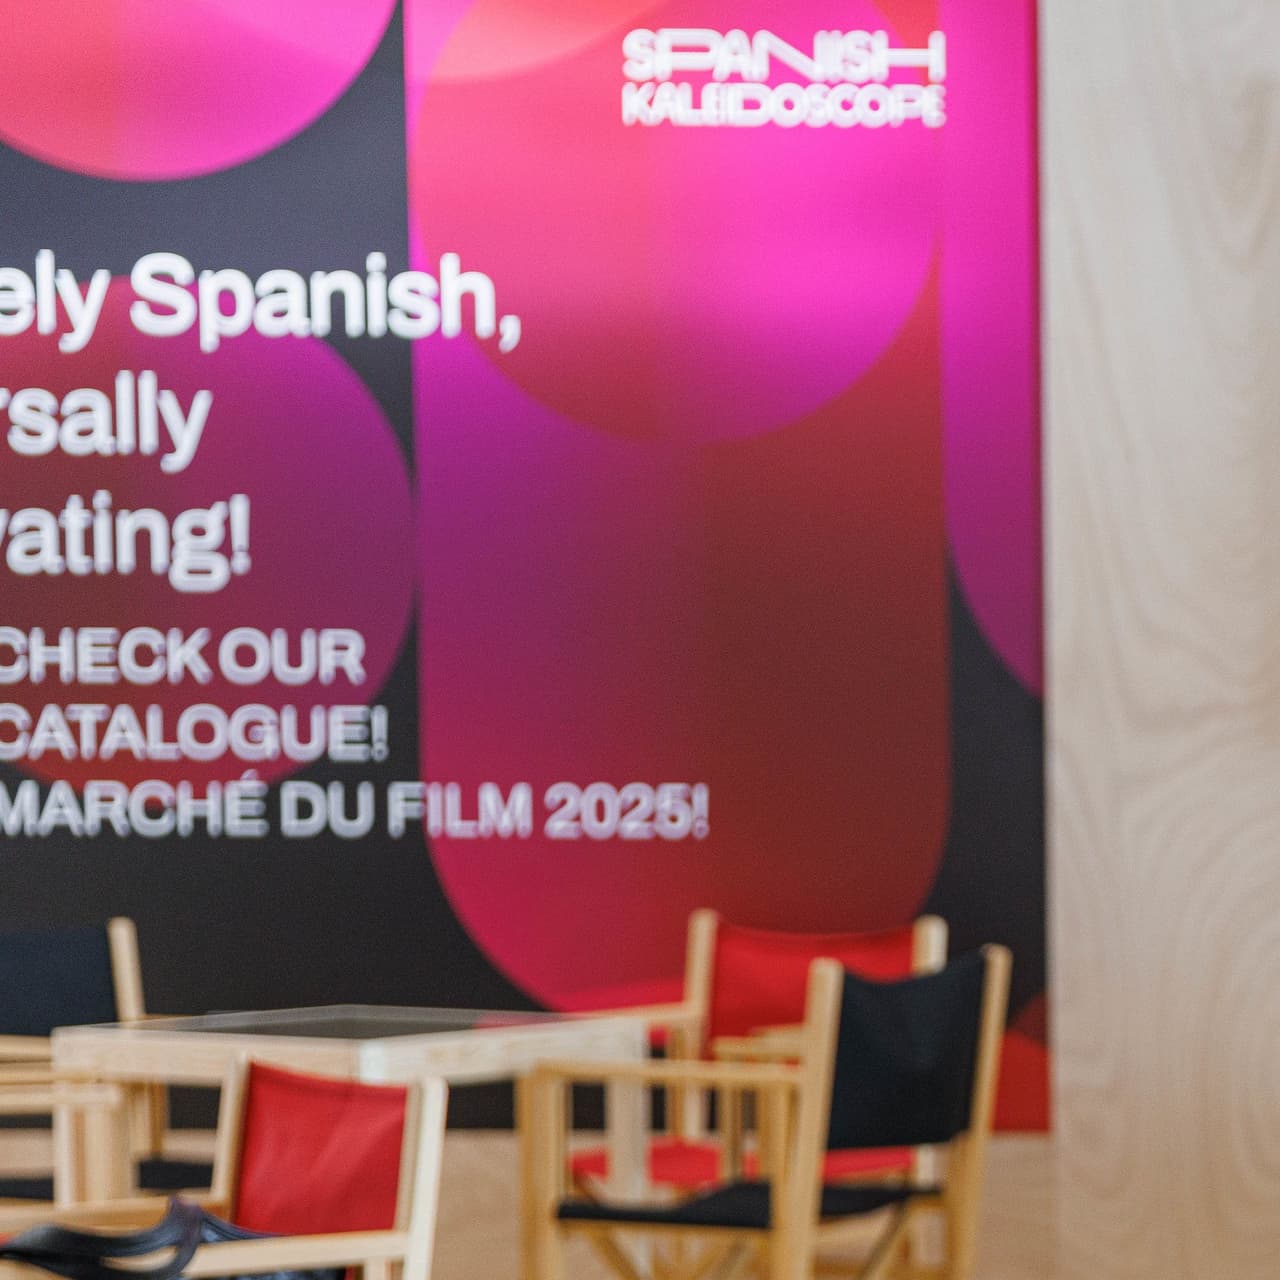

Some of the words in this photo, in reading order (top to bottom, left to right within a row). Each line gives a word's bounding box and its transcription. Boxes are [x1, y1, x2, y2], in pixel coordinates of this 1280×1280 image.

[622, 28, 946, 81] SPANISH
[622, 81, 946, 128] KALEIDOSCOPE
[129, 251, 521, 353] Spanish,
[0, 369, 212, 473] sally
[218, 627, 365, 685] OUR
[0, 702, 387, 761] CATALOGUE!
[0, 769, 266, 837] MARCHÉ
[280, 780, 375, 838] DU
[387, 781, 533, 838] FILM
[544, 782, 709, 839] 2025!
